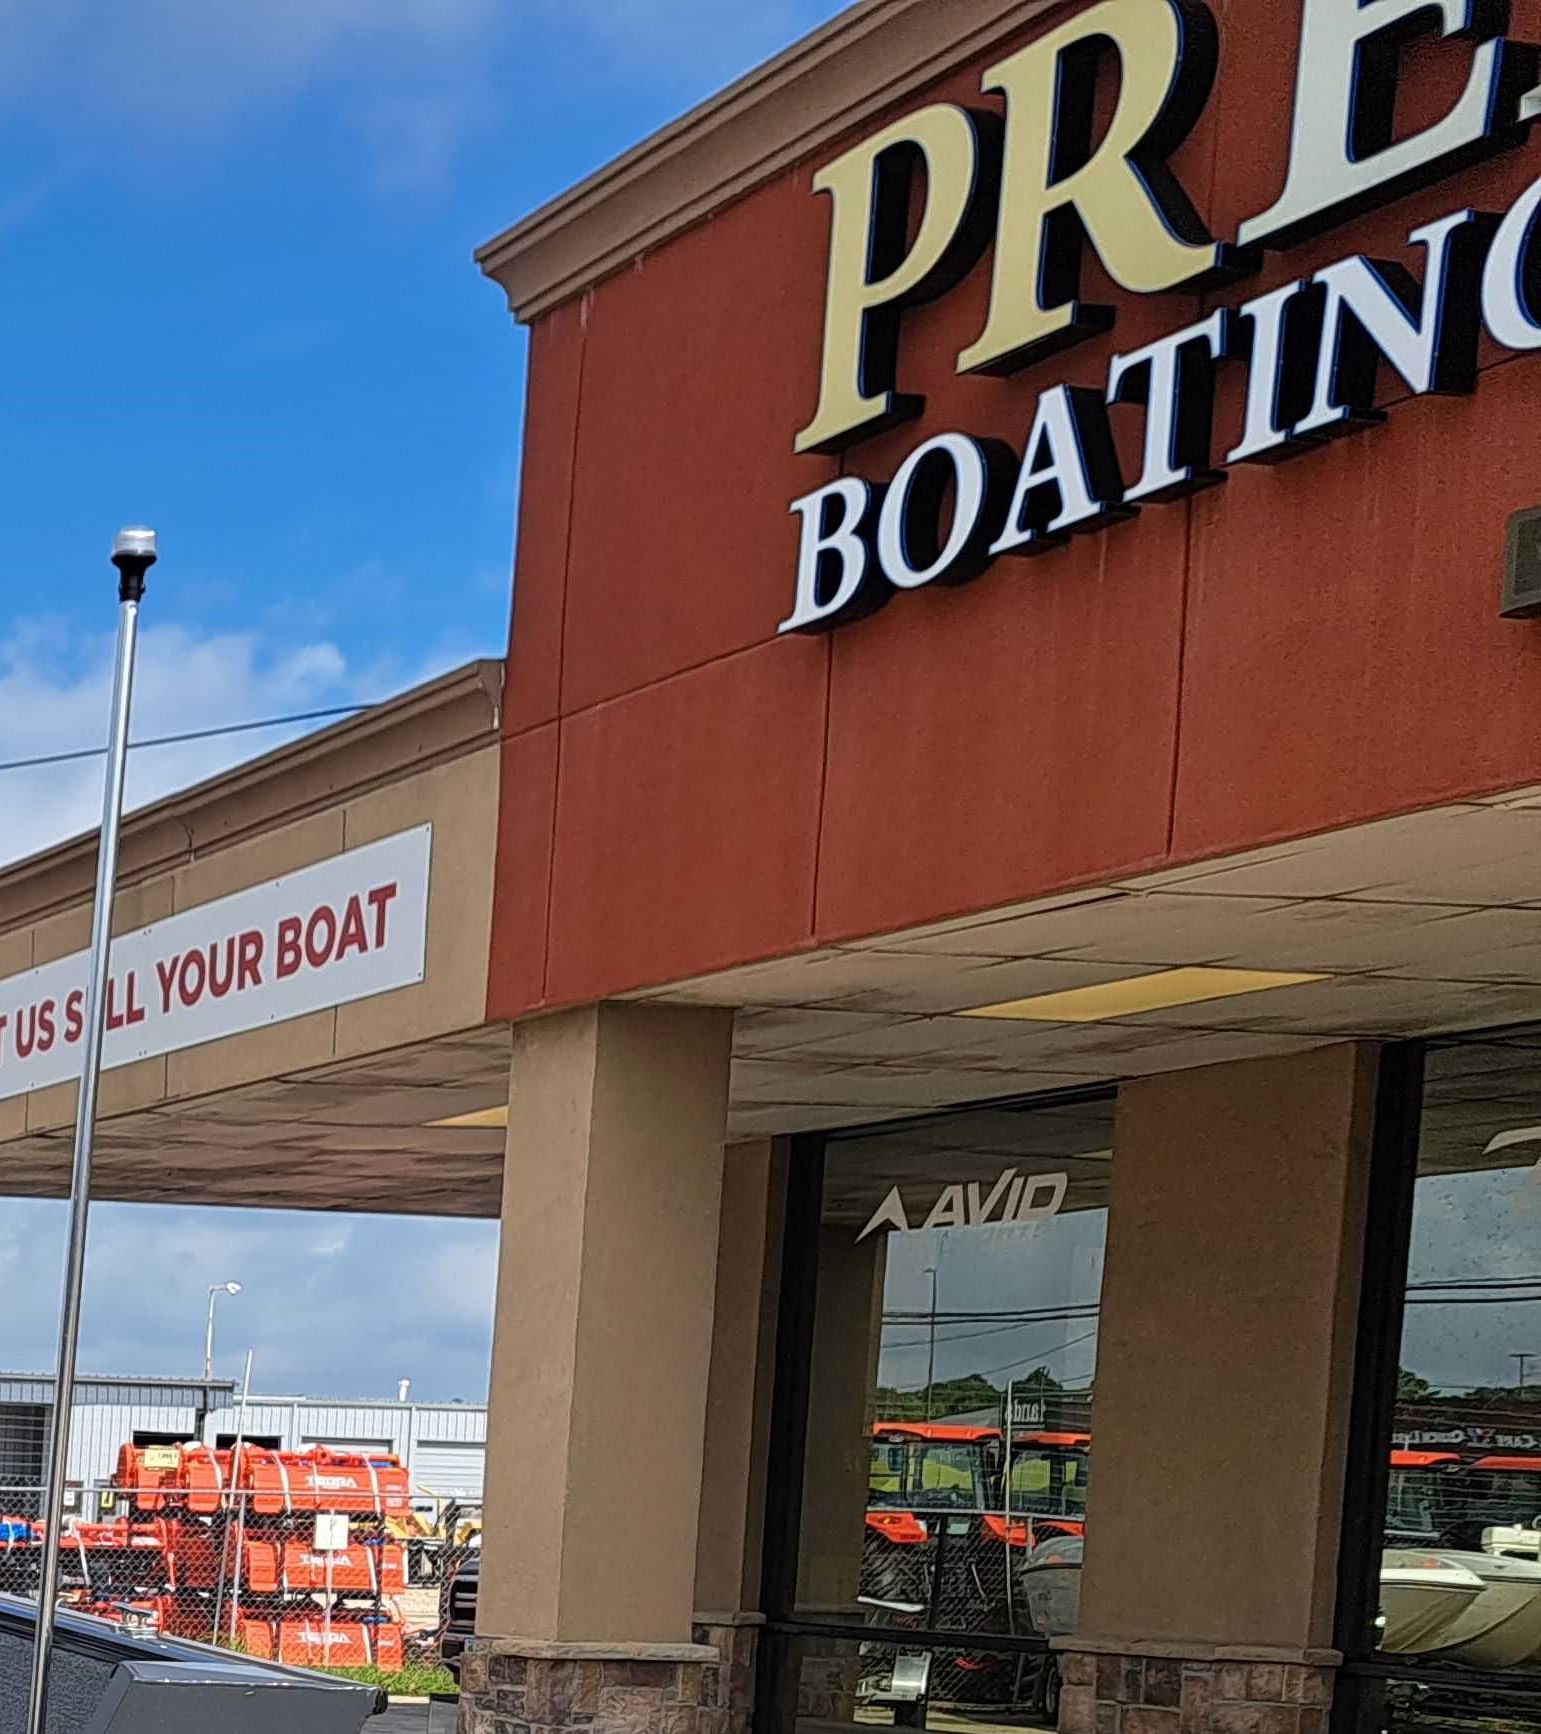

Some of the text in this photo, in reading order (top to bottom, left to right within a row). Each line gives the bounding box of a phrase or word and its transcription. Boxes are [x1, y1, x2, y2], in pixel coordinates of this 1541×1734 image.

[793, 0, 1541, 454] PRE
[15, 1000, 56, 1058] US
[64, 970, 146, 1043] SLL
[155, 930, 265, 1014] YOUR
[275, 881, 399, 980] BOAT
[920, 1167, 1068, 1231] AVID
